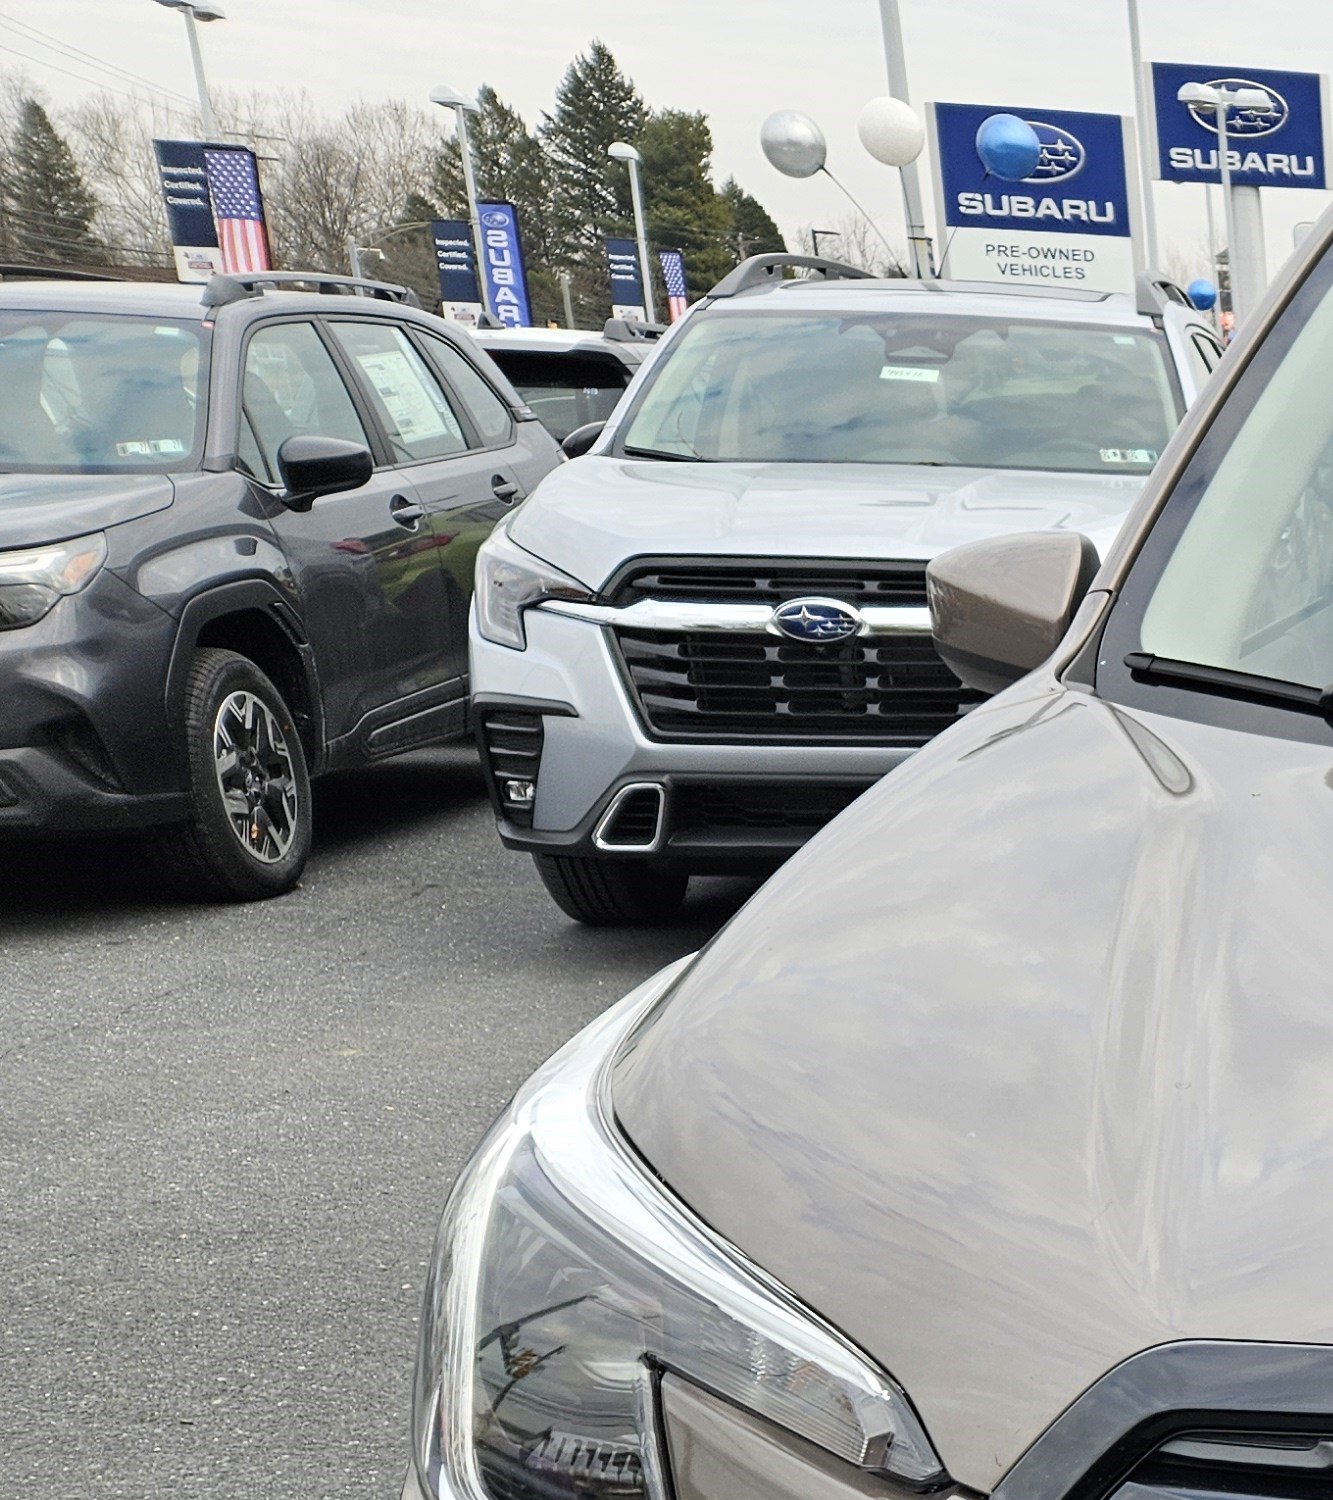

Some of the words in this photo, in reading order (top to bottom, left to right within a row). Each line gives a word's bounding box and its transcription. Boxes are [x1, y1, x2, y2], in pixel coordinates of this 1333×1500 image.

[1169, 147, 1315, 176] SUBARU
[957, 192, 1115, 223] SUBARU
[985, 244, 1095, 262] PRE-OWNED
[997, 263, 1086, 280] VEHICLES
